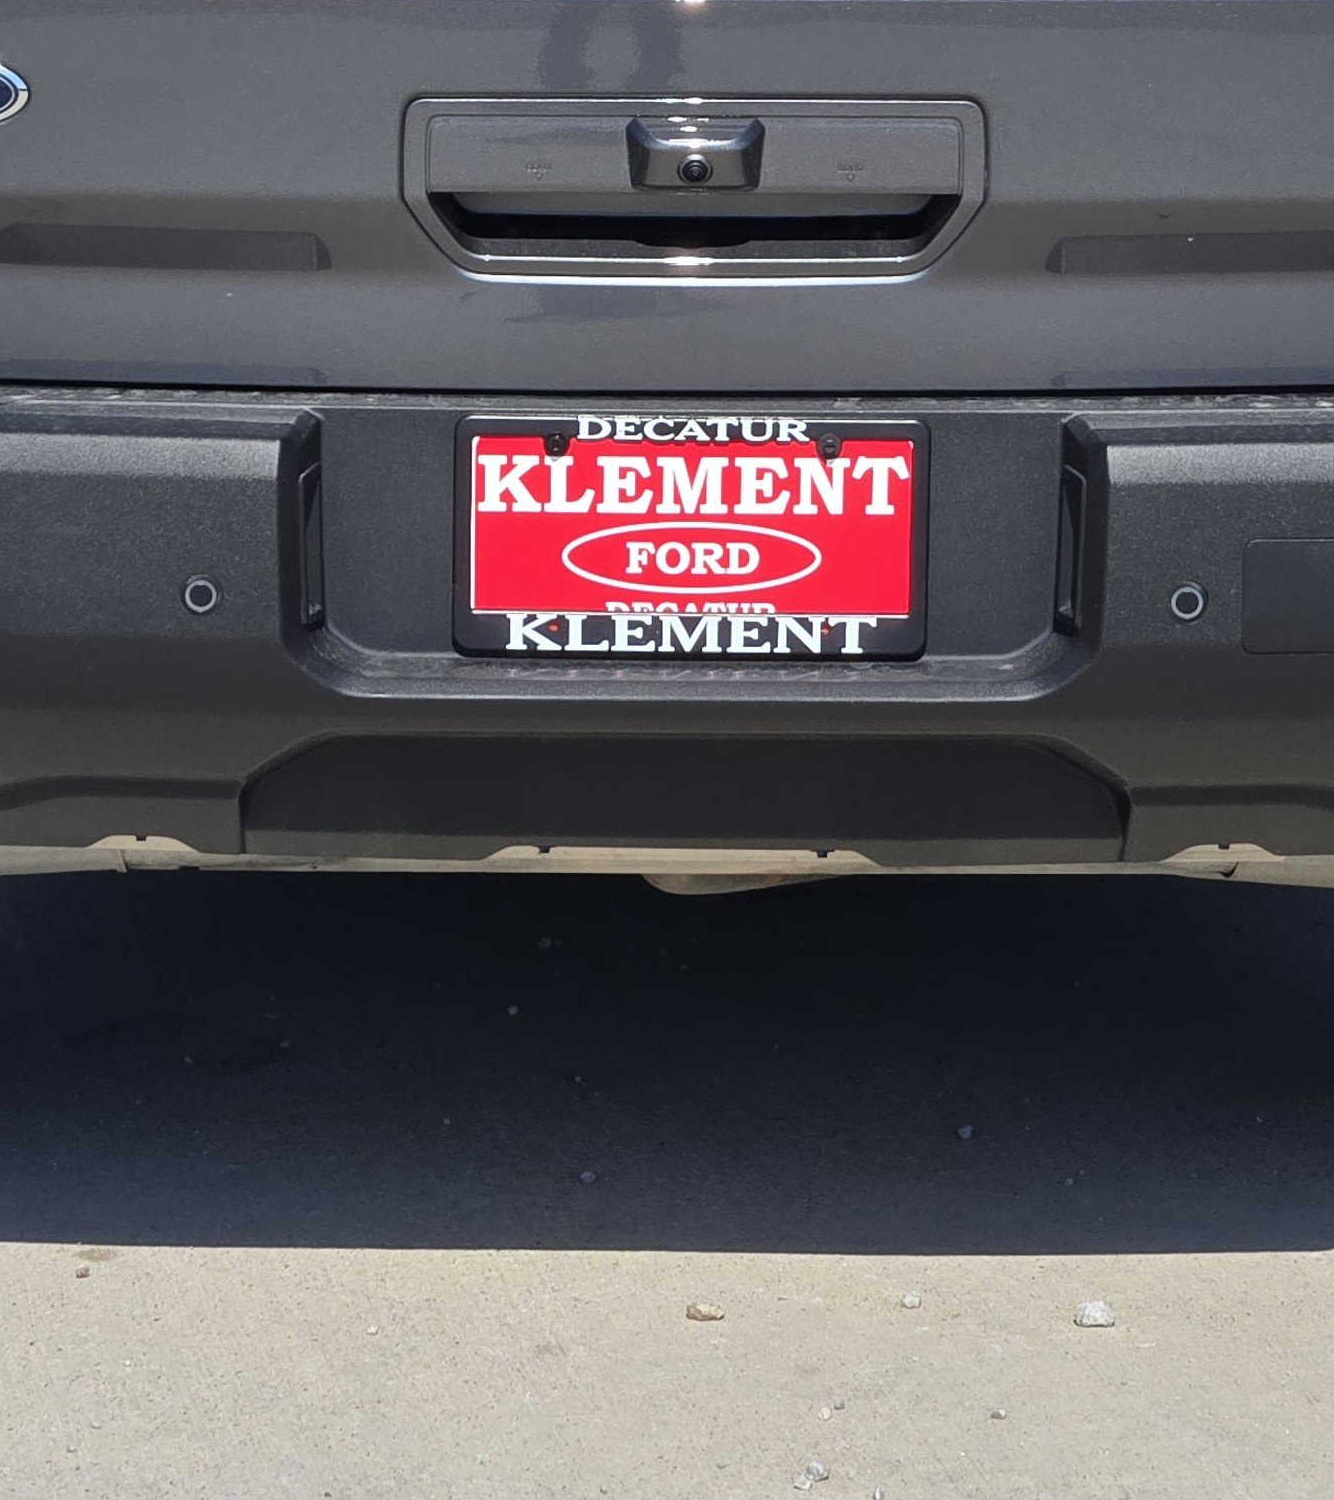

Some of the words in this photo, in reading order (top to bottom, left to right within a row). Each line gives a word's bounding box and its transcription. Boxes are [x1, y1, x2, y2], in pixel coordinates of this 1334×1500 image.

[577, 416, 810, 443] DECATUR
[477, 454, 910, 516] KLEMENT
[625, 541, 761, 576] FORD
[505, 613, 877, 655] KLEMENT
